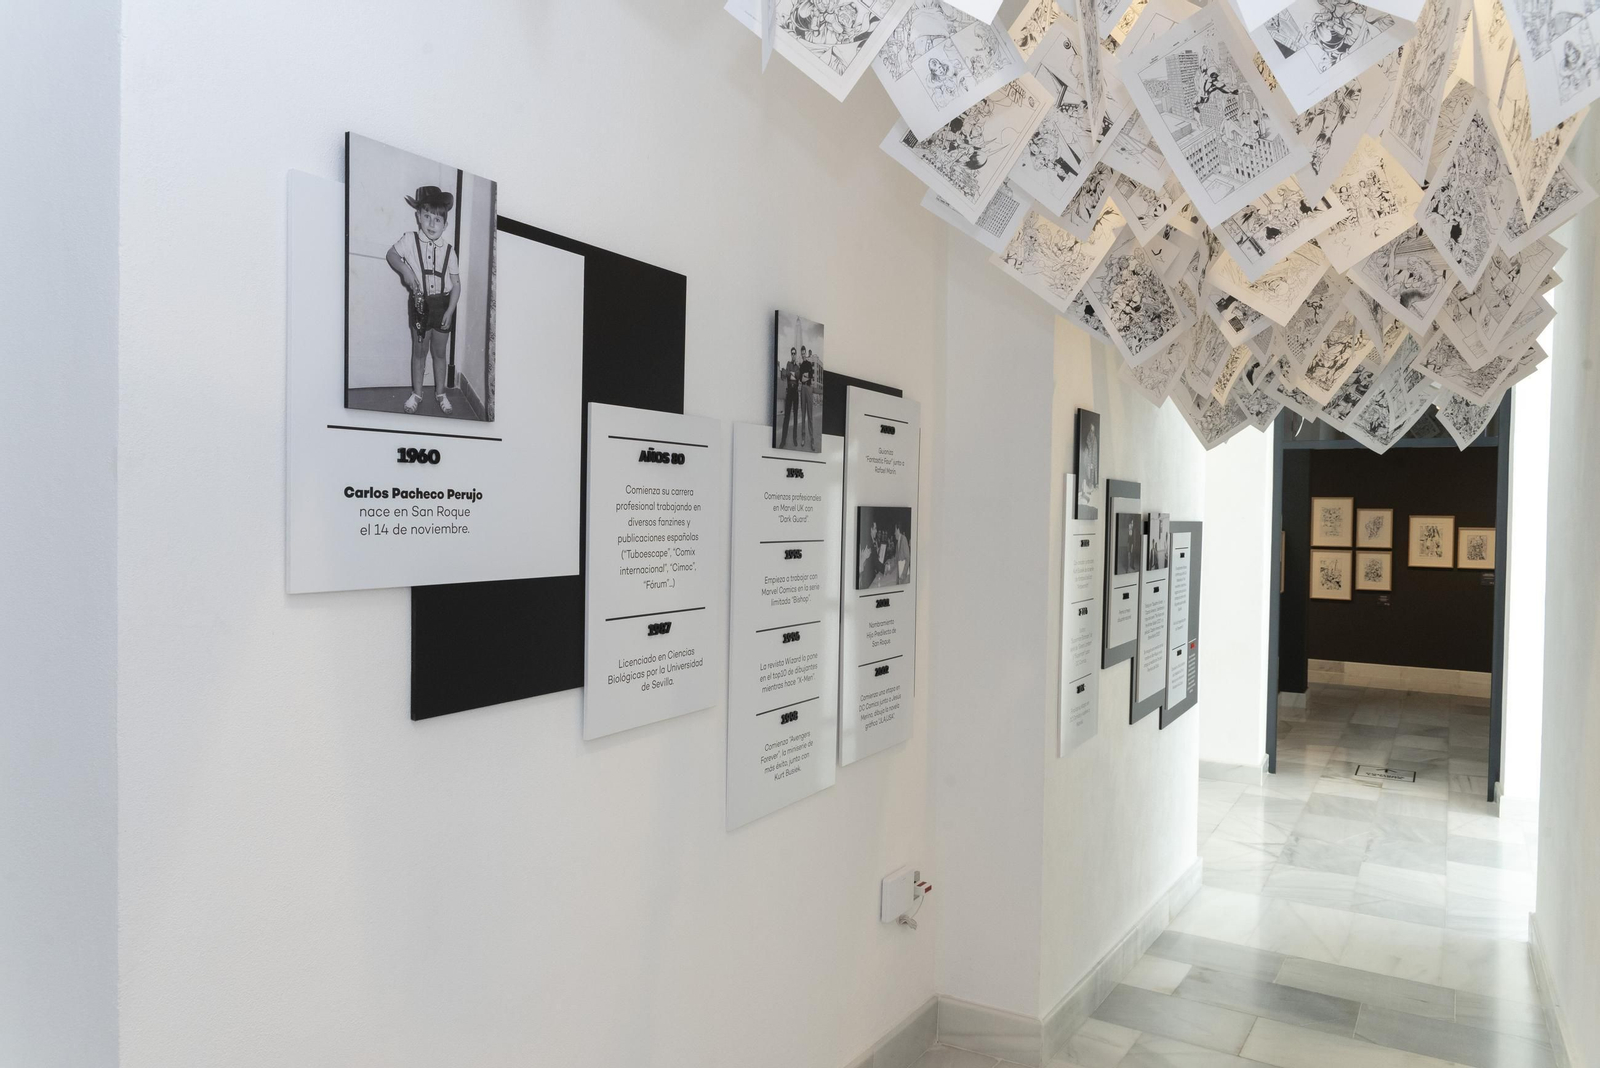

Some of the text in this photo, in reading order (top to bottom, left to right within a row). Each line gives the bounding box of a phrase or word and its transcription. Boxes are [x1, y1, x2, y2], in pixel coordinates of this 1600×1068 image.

[396, 448, 441, 464] 1960
[638, 447, 685, 465] AÑOS 80
[344, 486, 483, 503] Carlos Pacheco Perujo
[625, 485, 694, 496] Comienza su carrera
[764, 492, 821, 502] Comienzos profesionales
[360, 506, 470, 520] nace en San Roque
[616, 501, 655, 512] profesional
[656, 502, 692, 513] trabajando
[628, 517, 691, 528] diversos fanzines y
[360, 523, 470, 536] el 14 de noviembre.
[618, 532, 698, 545] publicaciones españolas
[764, 576, 785, 585] Empieza
[790, 574, 809, 583] trabajar
[761, 588, 778, 596] Marvel
[779, 585, 797, 595] Comics
[771, 597, 791, 606] limitada
[648, 622, 672, 636] 1987
[869, 619, 894, 629] Nombramiento
[618, 648, 695, 668] Licenciado en Ciencias
[760, 662, 767, 671] La
[767, 659, 784, 668] revista
[785, 655, 801, 665] Wizard
[807, 652, 818, 662] pone
[608, 658, 703, 685] Biológicas por la Universidad
[767, 673, 772, 681] el
[788, 668, 794, 676] de
[795, 663, 818, 675] dibujantes
[641, 678, 674, 691] de Sevilla.
[762, 682, 783, 693] mientras
[784, 679, 796, 688] hace
[764, 740, 788, 751] Comienza
[787, 744, 807, 756] miniserie
[764, 765, 775, 774] más
[774, 772, 785, 781] Kurt
